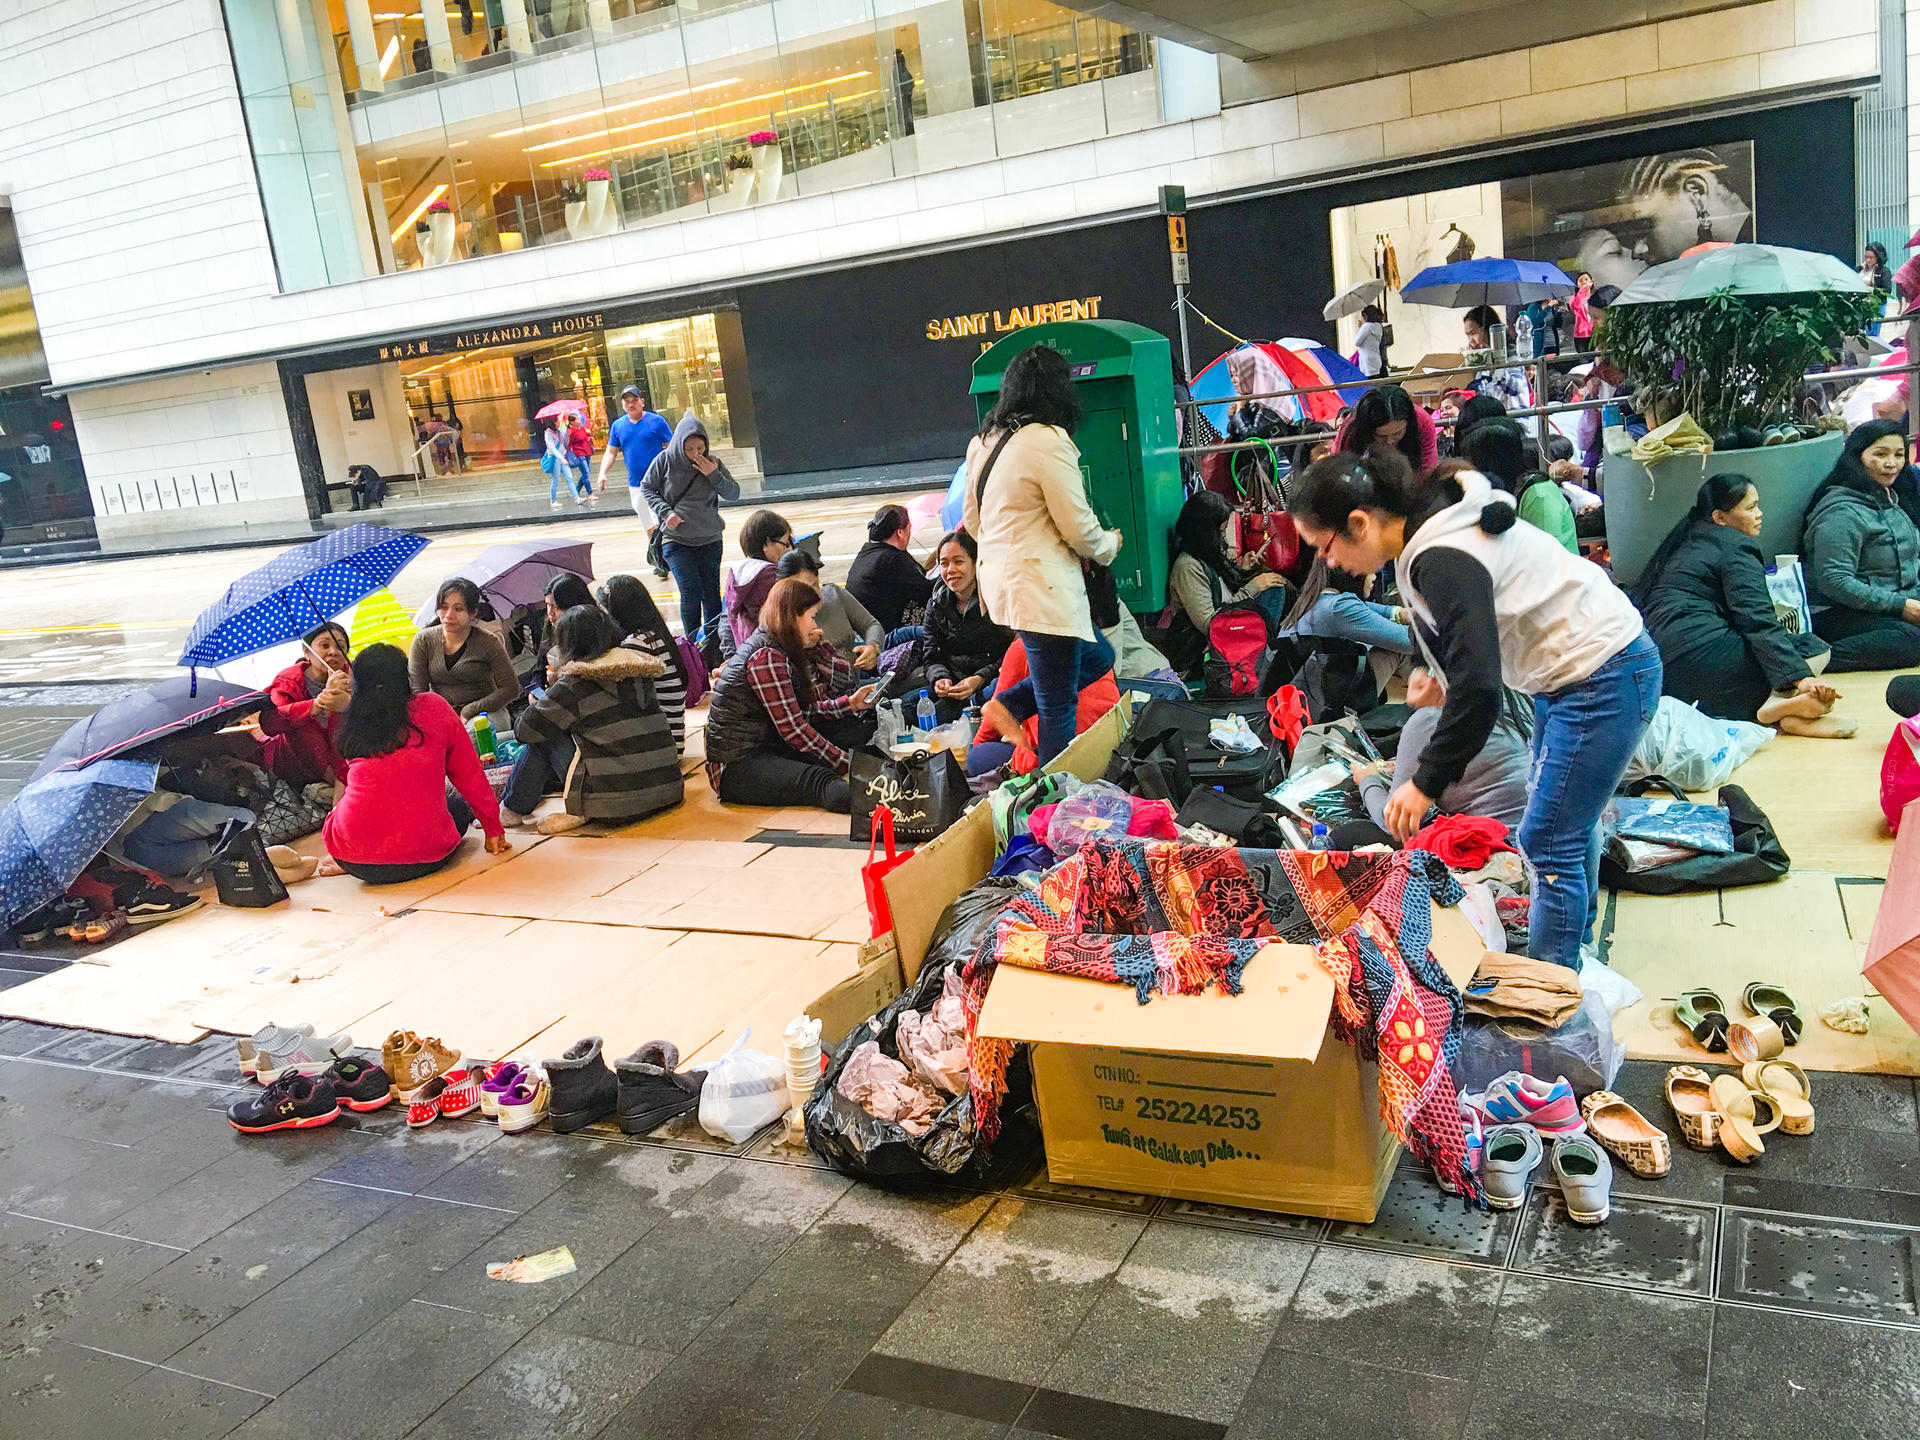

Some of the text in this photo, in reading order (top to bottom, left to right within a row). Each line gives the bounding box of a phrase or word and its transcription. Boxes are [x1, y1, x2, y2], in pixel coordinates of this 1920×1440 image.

[456, 313, 605, 348] ALEXANDRA HOUSE
[926, 296, 1102, 340] SAINT LAURENT
[1093, 1064, 1117, 1081] CTN
[1097, 1094, 1261, 1131] TEL# 25224253
[1147, 1137, 1183, 1164] Galak
[1183, 1148, 1206, 1169] ang
